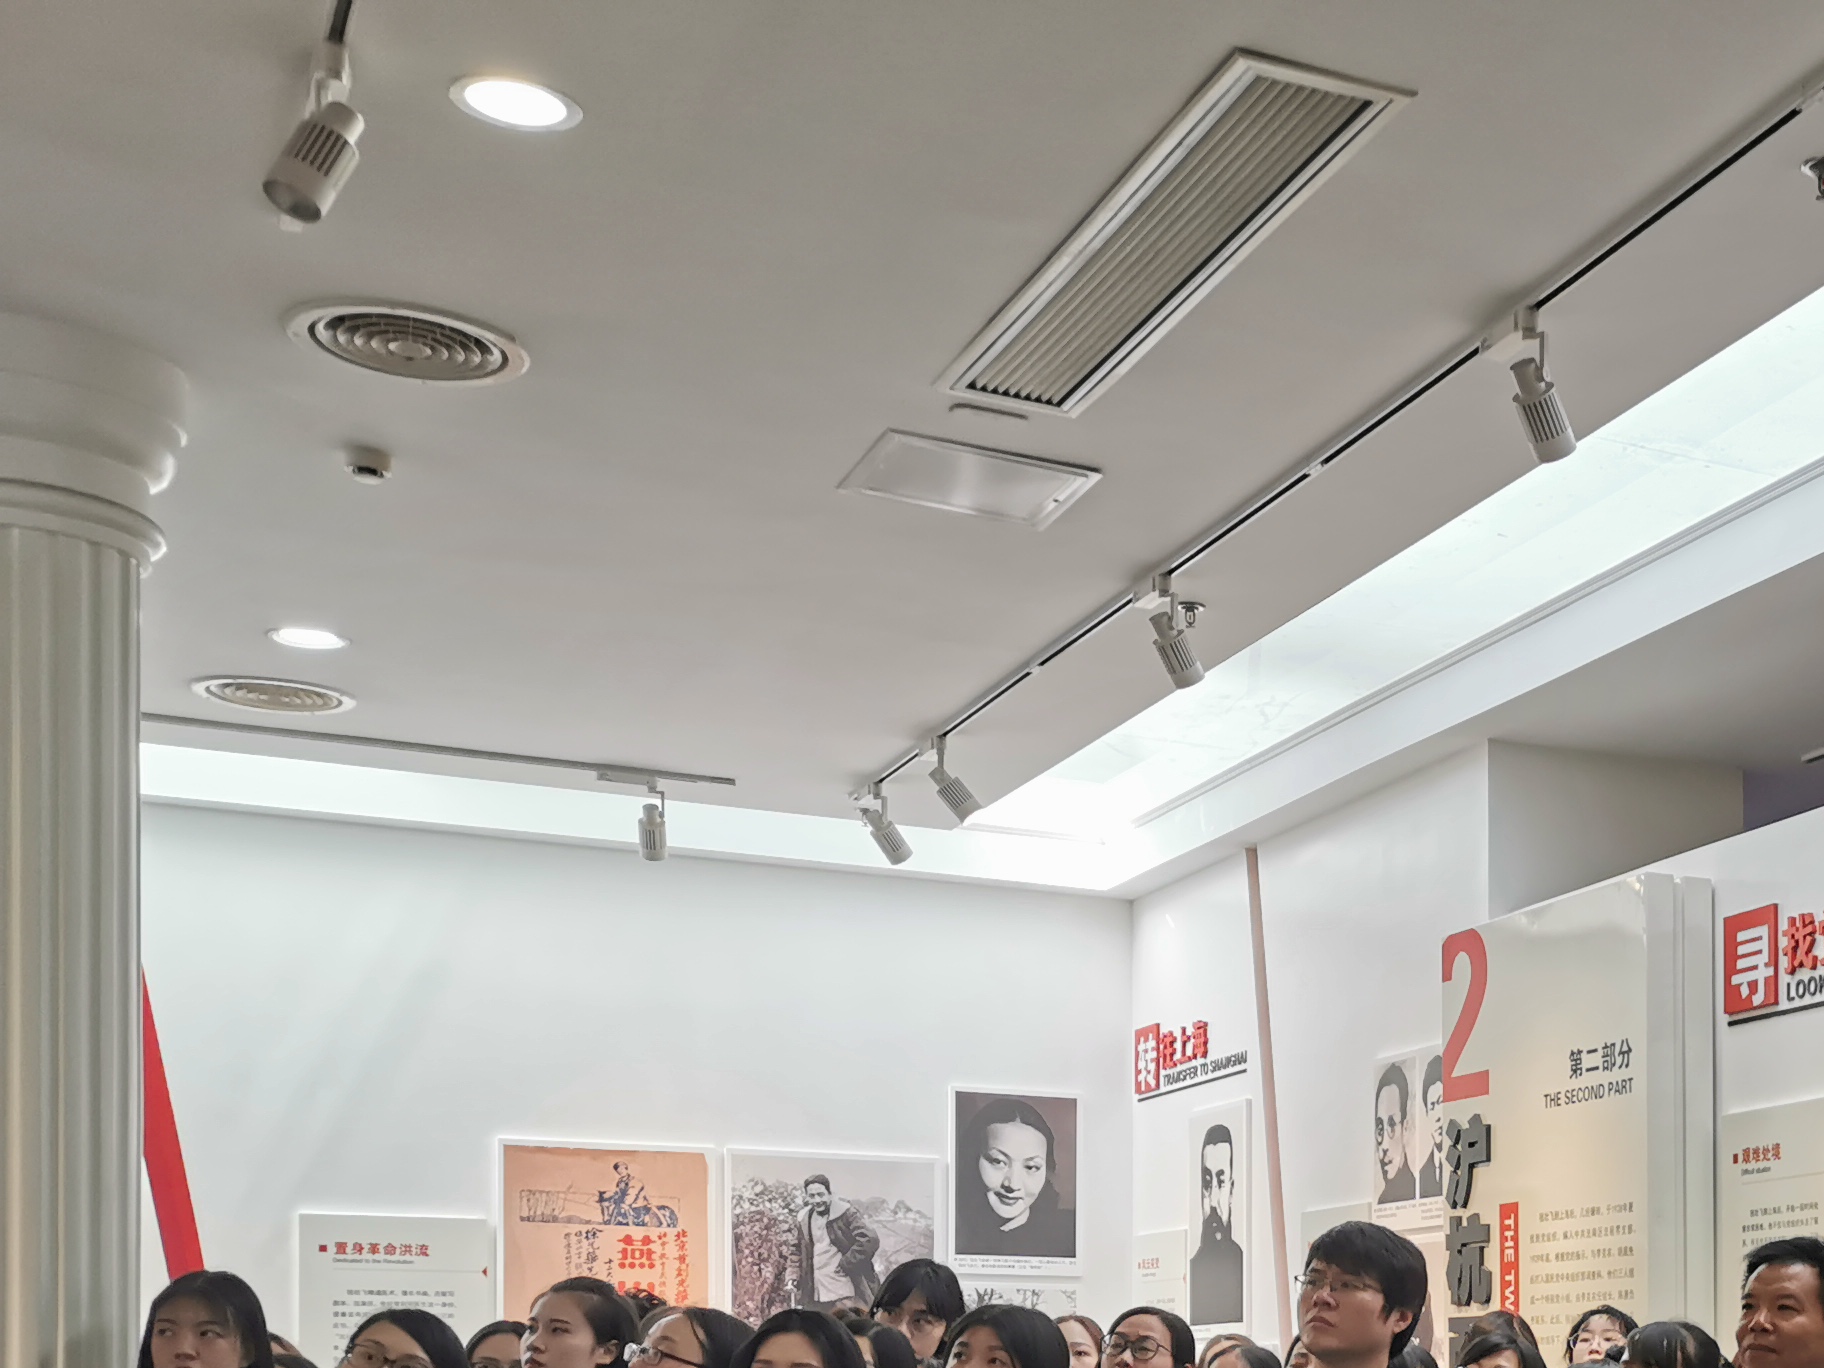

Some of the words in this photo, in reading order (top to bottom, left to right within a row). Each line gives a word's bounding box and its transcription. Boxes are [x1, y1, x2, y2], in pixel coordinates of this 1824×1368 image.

[1441, 927, 1490, 1102] 2
[1162, 1063, 1199, 1087] TRANSFER
[1199, 1061, 1209, 1077] TO
[1568, 1038, 1633, 1079] 第二部分
[1544, 1091, 1561, 1108] THE
[1564, 1083, 1605, 1105] SECOND
[1607, 1077, 1634, 1097] PART
[333, 1241, 431, 1257] 置身革命洪流
[1503, 1213, 1515, 1263] THE
